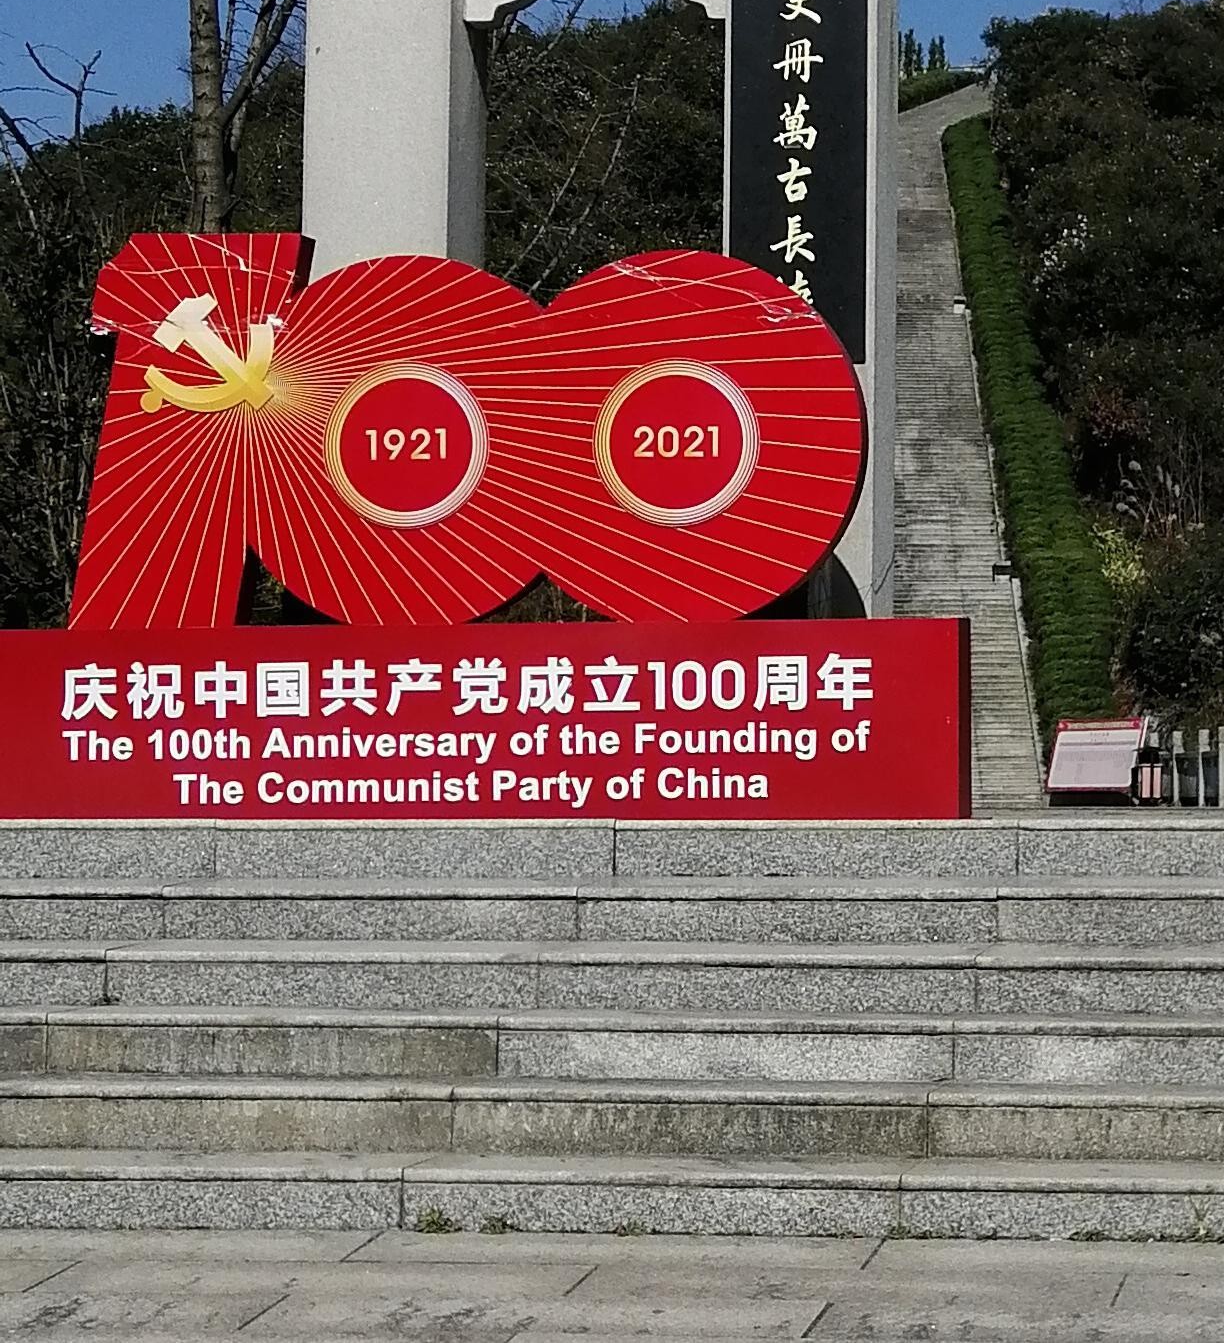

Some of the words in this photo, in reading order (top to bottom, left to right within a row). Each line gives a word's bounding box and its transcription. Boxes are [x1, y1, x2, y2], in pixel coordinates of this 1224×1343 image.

[365, 428, 447, 461] 1921
[633, 425, 720, 458] 2021
[61, 653, 874, 721] 庆祝中国共产党成立100周年
[62, 730, 134, 761] The
[147, 728, 251, 760] 100th
[262, 727, 496, 764] Anniversary
[509, 724, 551, 756] of
[560, 724, 620, 755] the
[634, 721, 818, 760] Founding
[831, 720, 871, 752] of
[173, 773, 245, 805] The
[257, 771, 480, 805] Communist
[492, 770, 593, 808] Party
[606, 768, 645, 800] of
[657, 767, 769, 800] China
